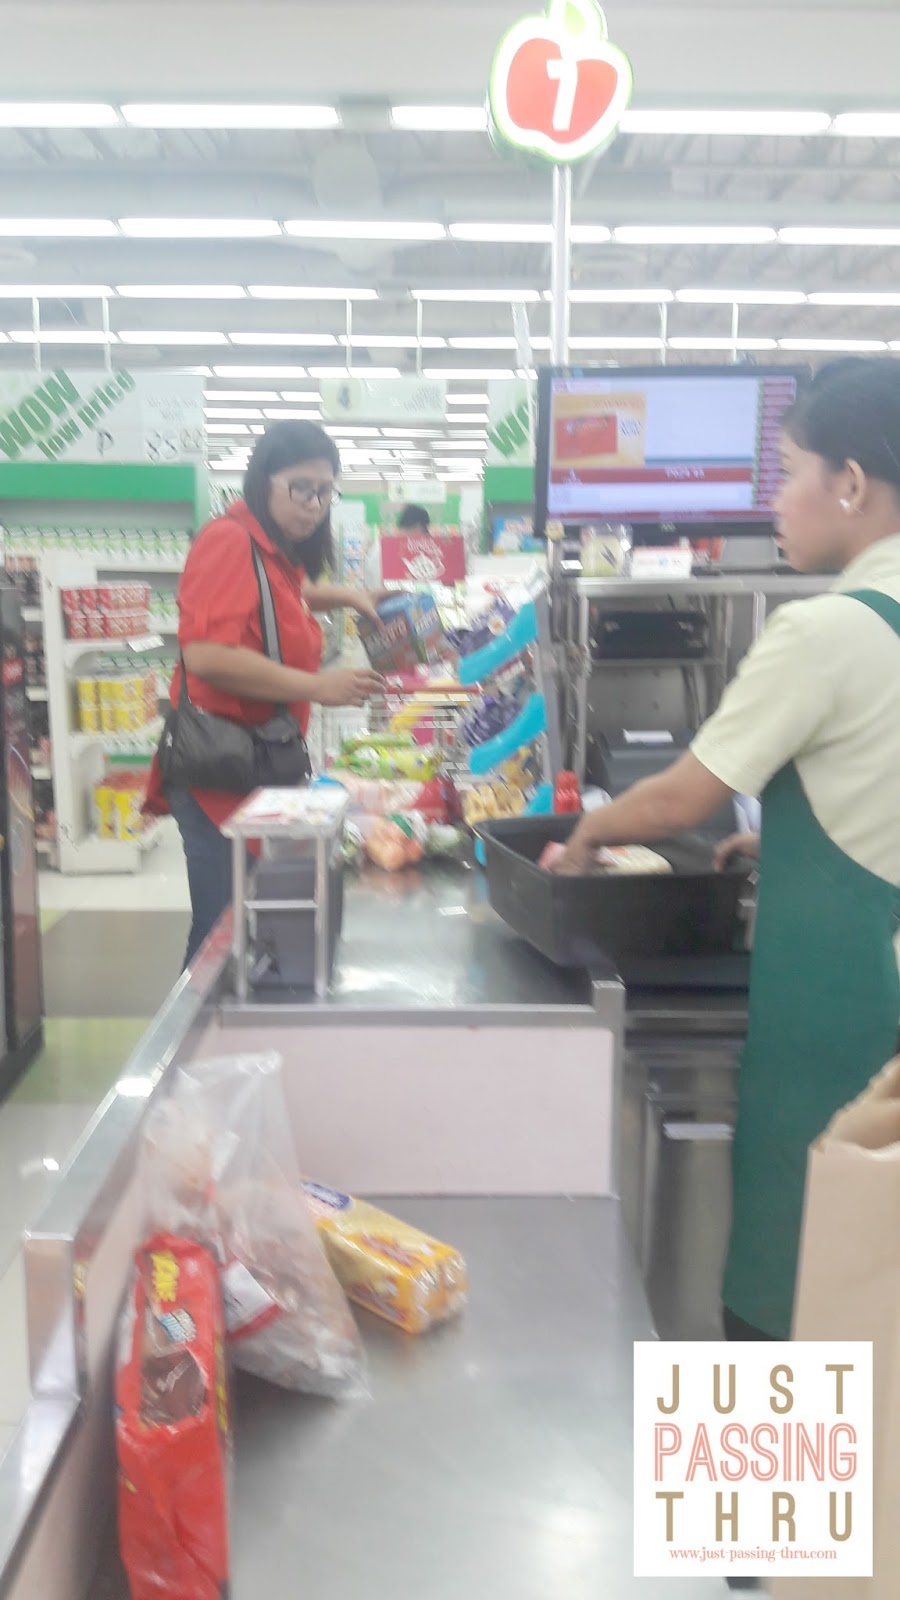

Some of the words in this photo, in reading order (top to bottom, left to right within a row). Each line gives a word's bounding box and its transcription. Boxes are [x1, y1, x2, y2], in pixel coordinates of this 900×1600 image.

[545, 58, 579, 131] 1
[0, 369, 81, 460] WOW
[37, 416, 82, 461] low
[77, 368, 136, 431] price
